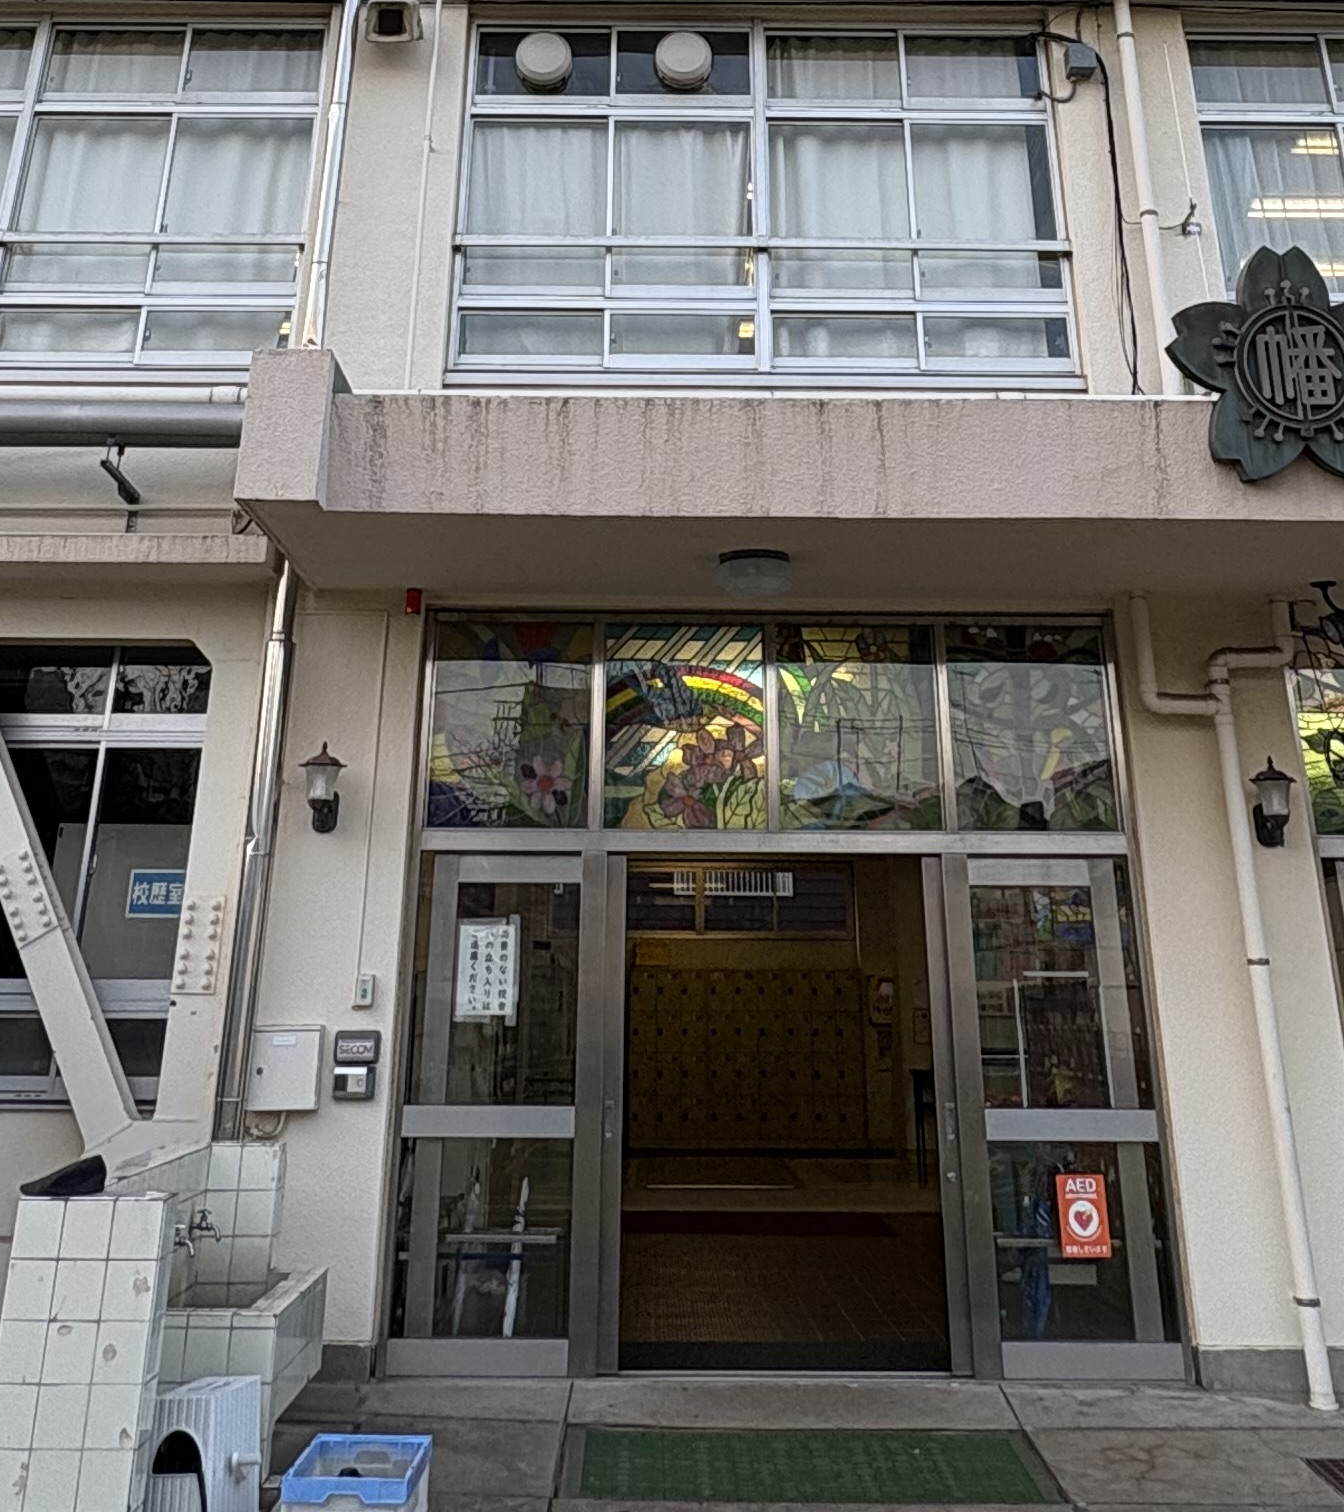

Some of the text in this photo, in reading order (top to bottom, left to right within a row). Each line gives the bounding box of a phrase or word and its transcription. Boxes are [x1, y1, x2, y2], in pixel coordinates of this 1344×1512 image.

[133, 882, 183, 905] 校歴室
[339, 1044, 373, 1055] SECOM
[1065, 1178, 1096, 1192] AED
